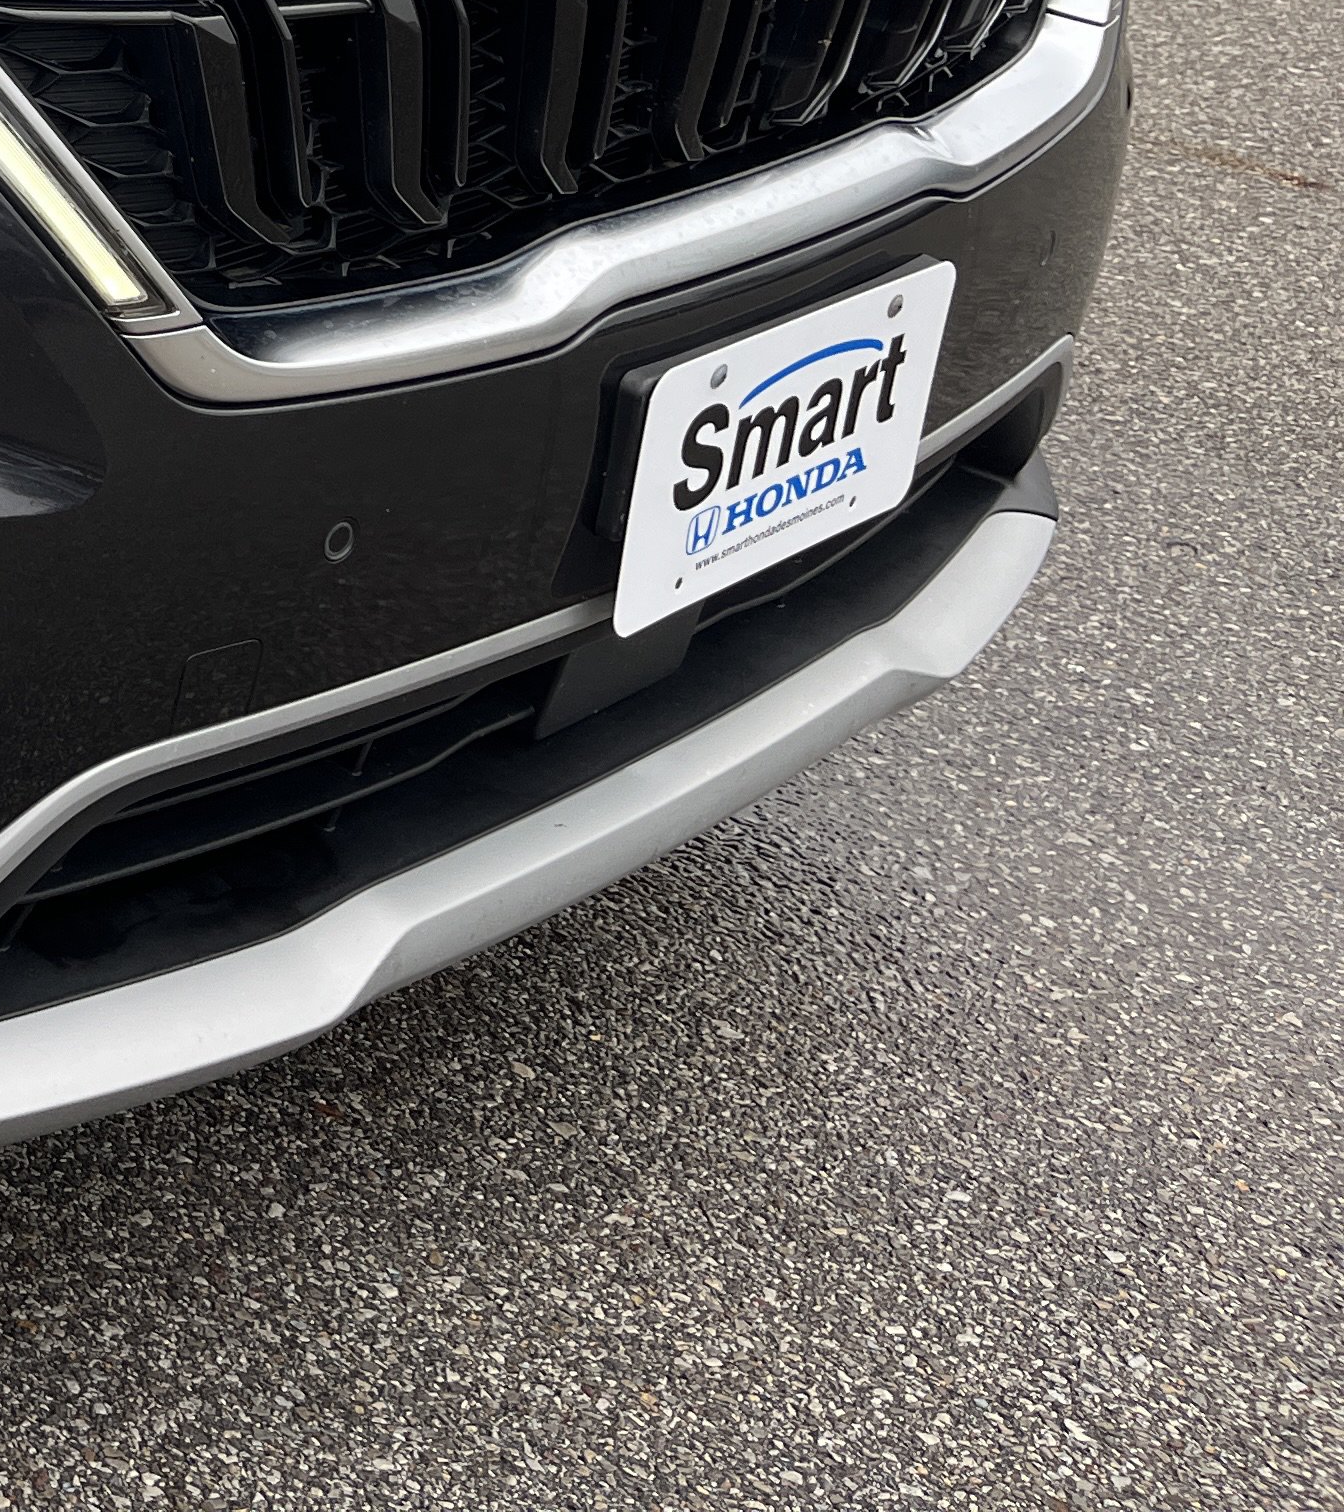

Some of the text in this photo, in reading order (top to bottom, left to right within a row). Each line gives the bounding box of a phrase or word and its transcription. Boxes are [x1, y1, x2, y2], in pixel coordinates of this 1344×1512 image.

[672, 333, 906, 512] Smart
[695, 494, 845, 571] www.smarthondadesmoines.com
[722, 447, 867, 535] HONDA
